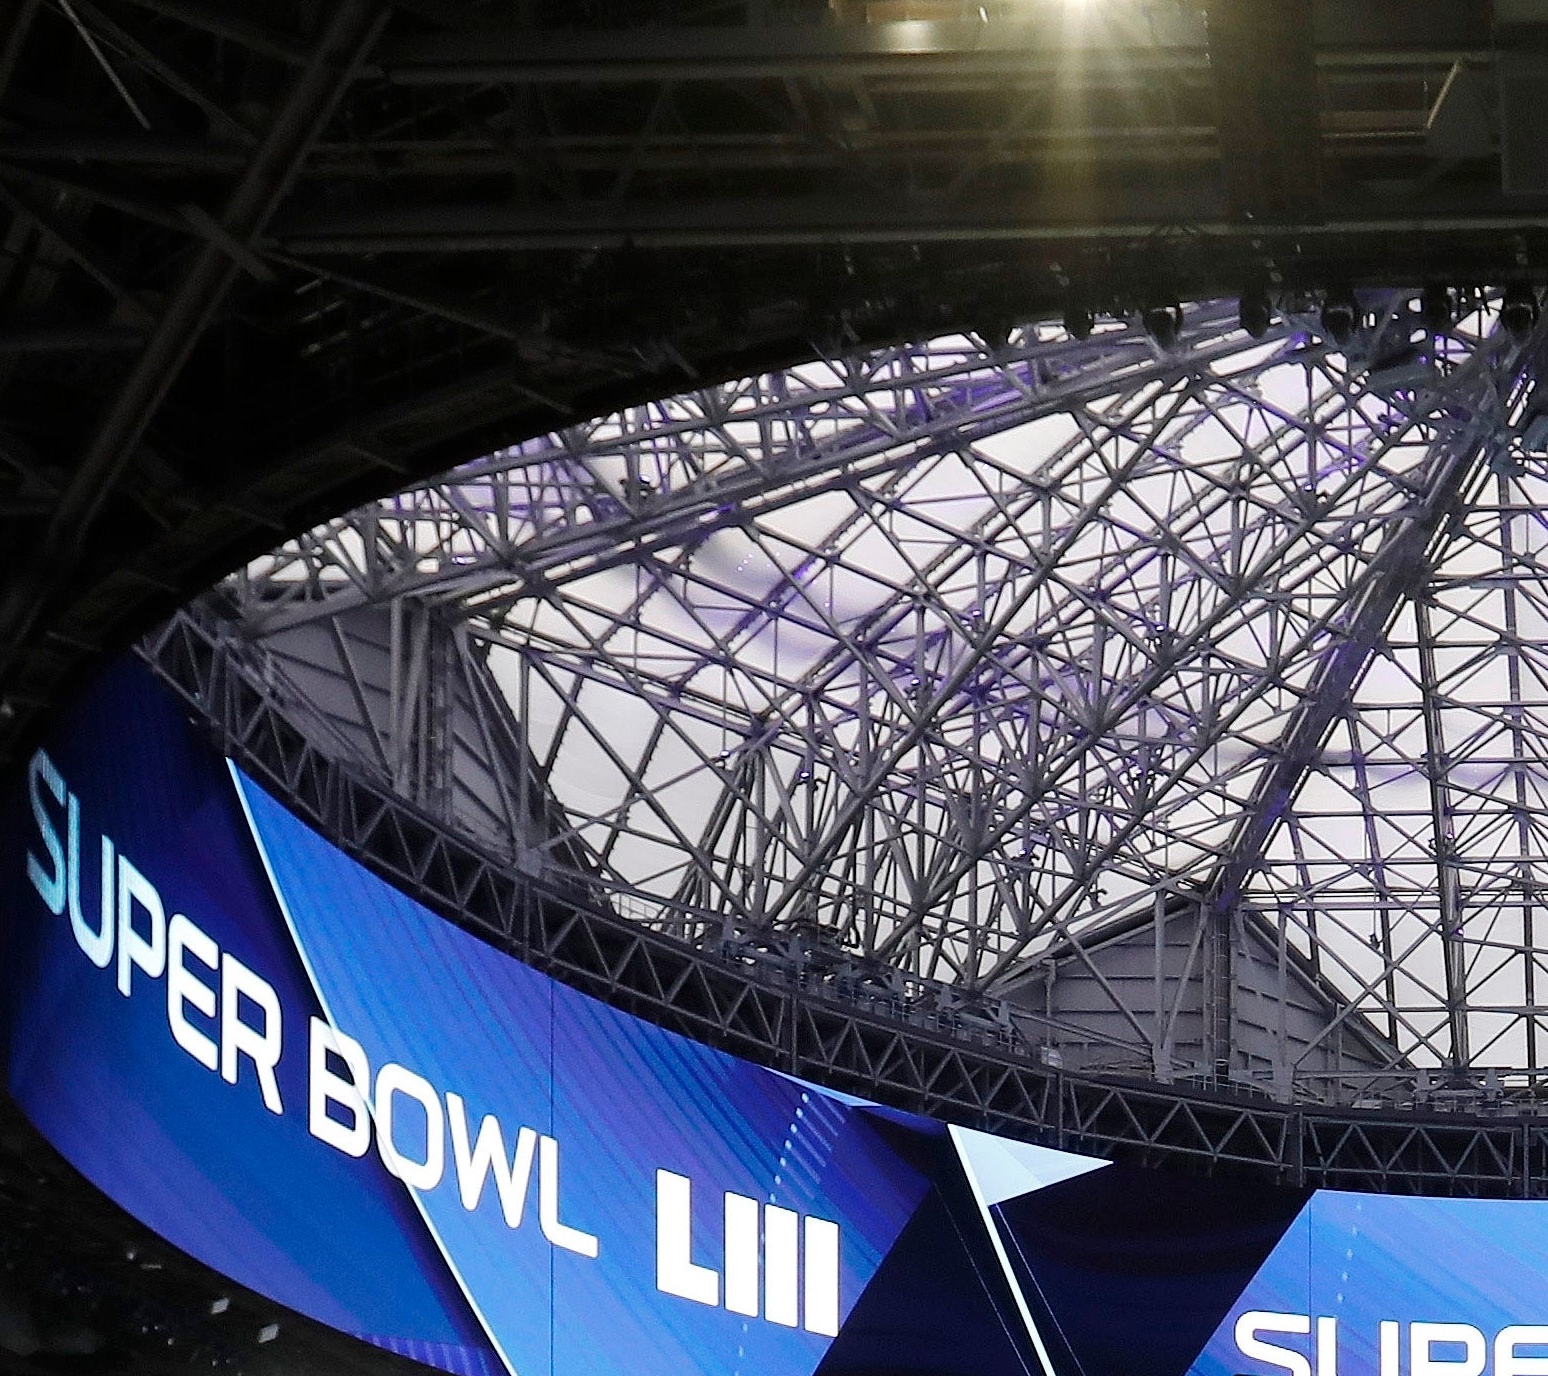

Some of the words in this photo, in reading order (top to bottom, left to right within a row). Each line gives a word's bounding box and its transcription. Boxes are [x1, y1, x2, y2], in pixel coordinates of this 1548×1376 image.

[28, 747, 284, 1116] SUPER
[308, 1014, 600, 1261] BOWL
[656, 1167, 840, 1337] LIII
